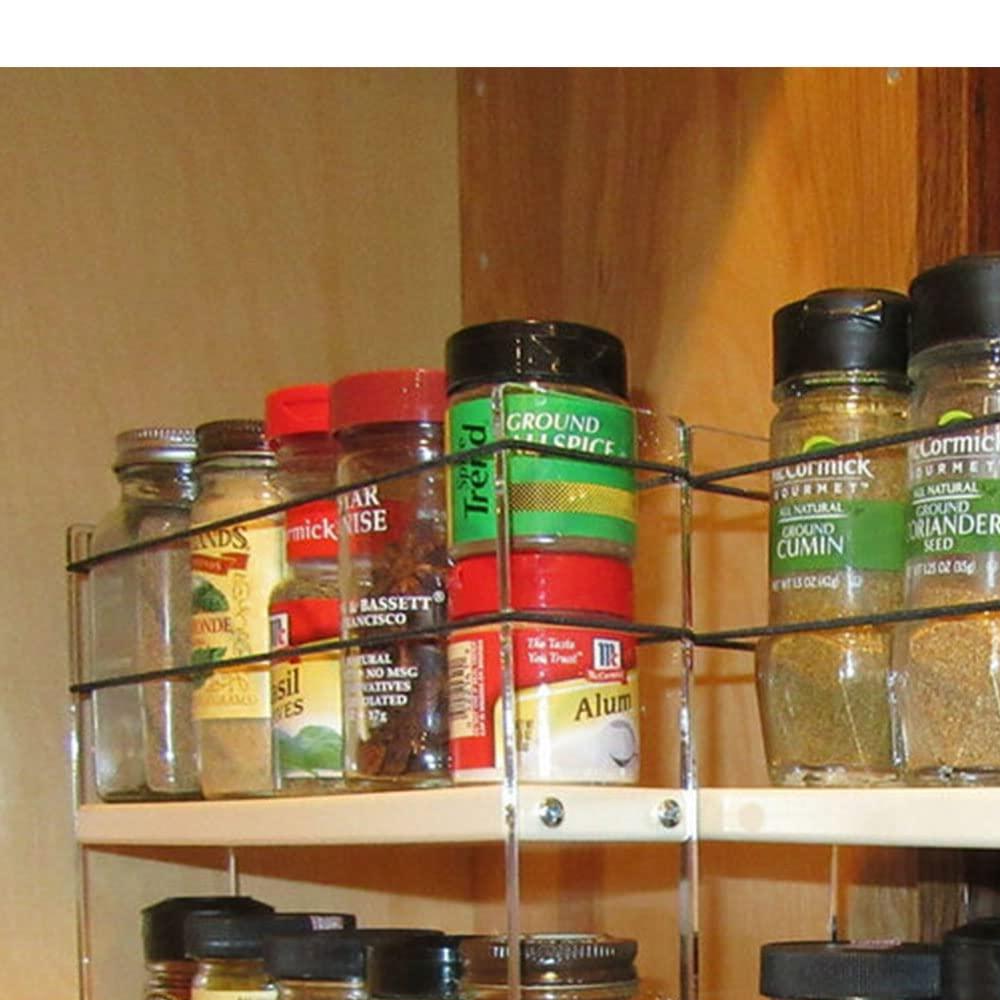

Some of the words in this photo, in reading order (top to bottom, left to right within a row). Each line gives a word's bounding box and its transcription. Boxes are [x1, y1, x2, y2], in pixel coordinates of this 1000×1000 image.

[506, 412, 600, 433] GROUND
[772, 452, 875, 481] Cormick
[777, 535, 845, 560] CUMIN
[924, 537, 954, 552] SEED
[273, 668, 300, 700] sil
[575, 692, 632, 721] Alum
